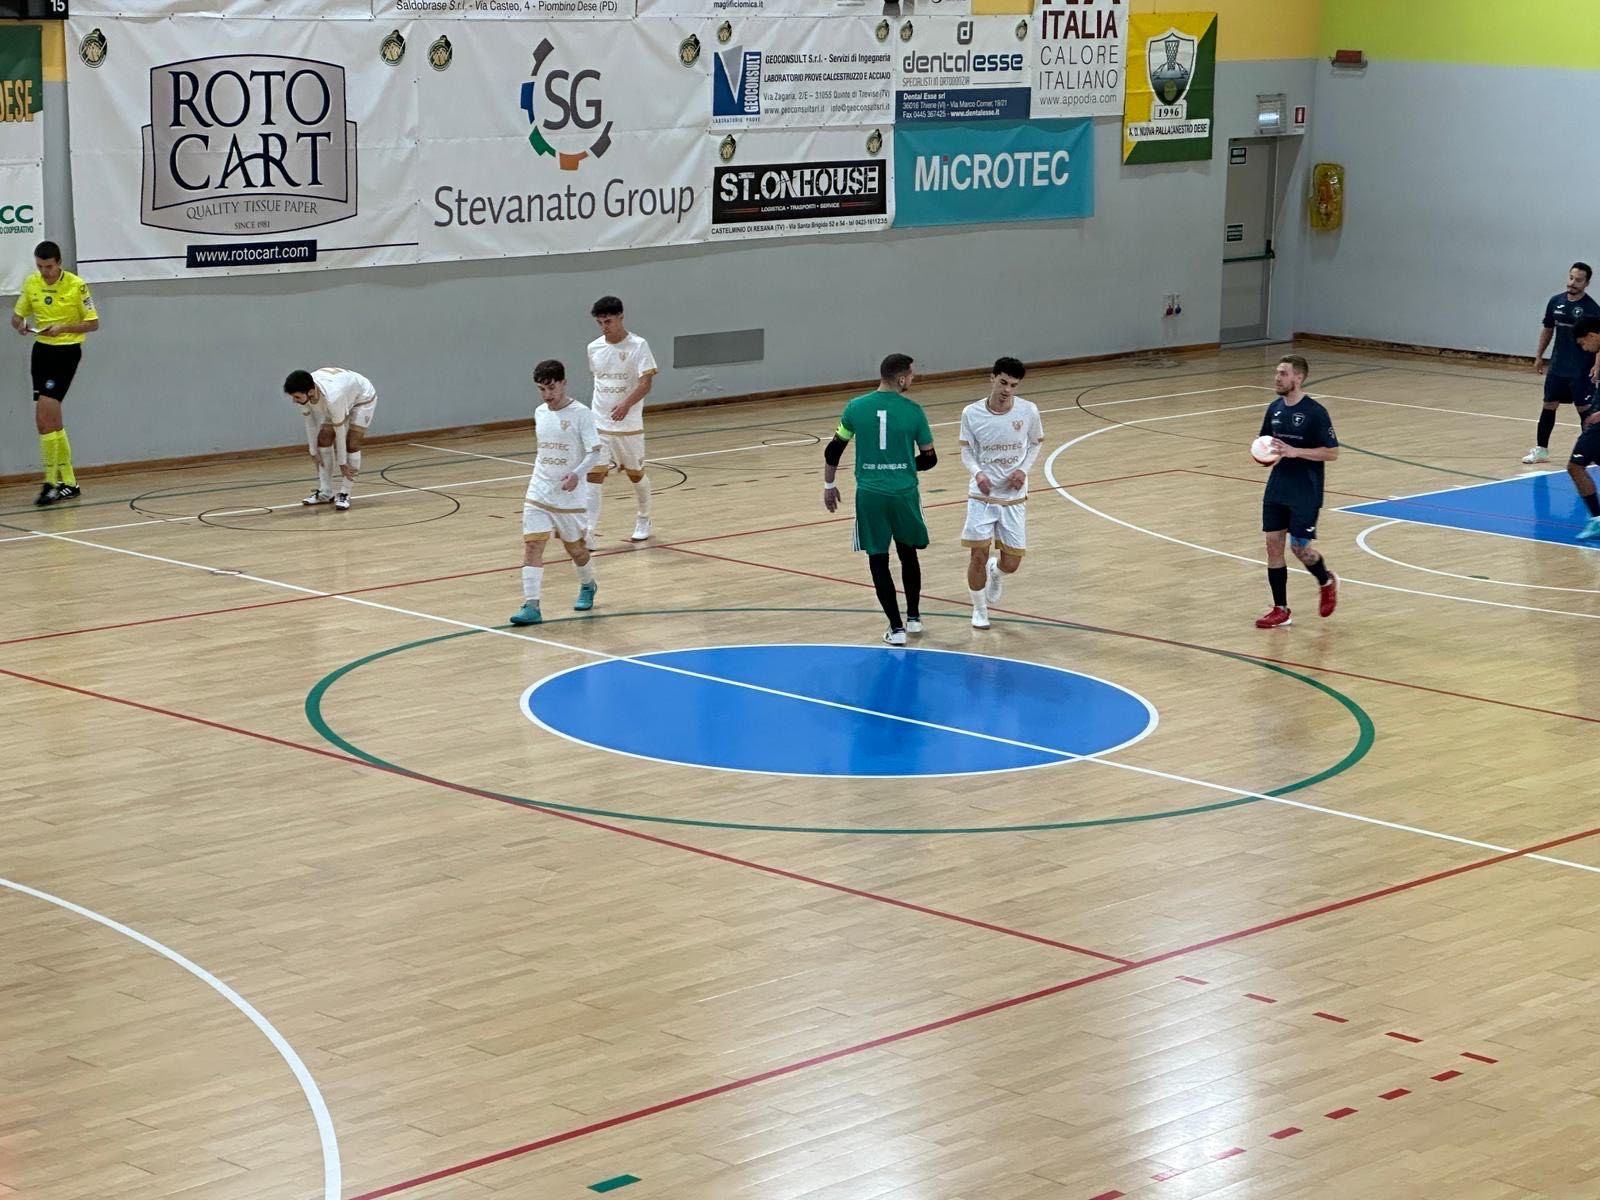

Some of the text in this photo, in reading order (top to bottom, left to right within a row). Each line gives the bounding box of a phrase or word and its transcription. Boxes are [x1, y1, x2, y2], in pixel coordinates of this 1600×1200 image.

[50, 0, 66, 12] 15
[396, 0, 448, 11] Saldobrase
[475, 0, 488, 11] Via
[524, 1, 530, 11] 4
[538, 0, 576, 12] Piombino
[577, 1, 598, 12] Dese
[599, 1, 618, 12] (PD)
[1042, 10, 1118, 39] ITALIA
[765, 54, 807, 64] GEOCONSULT
[829, 54, 850, 63] Servizi
[850, 53, 857, 62] di
[858, 53, 891, 64] Ingegneria
[1040, 45, 1119, 65] CALORE
[744, 54, 761, 113] GEOCONSULT
[764, 72, 891, 82] LABORATORIO PROVE CALCESTRUZZO E ACCIAIO
[1039, 69, 1119, 90] ITALIANO
[169, 69, 331, 127] ROTO
[543, 70, 602, 130] SG
[763, 92, 774, 101] Via
[903, 92, 923, 100] Dental
[923, 92, 937, 100] Esse
[1039, 93, 1117, 106] www.appodia.com
[1193, 123, 1208, 133] DESE
[169, 131, 332, 191] CART
[186, 199, 318, 220] QUALITY TISSUE PAPER
[434, 178, 695, 227] Stevanato Group
[234, 220, 271, 229] SINCE 1981
[195, 246, 309, 262] www.rotocart.com
[876, 409, 887, 450] 1
